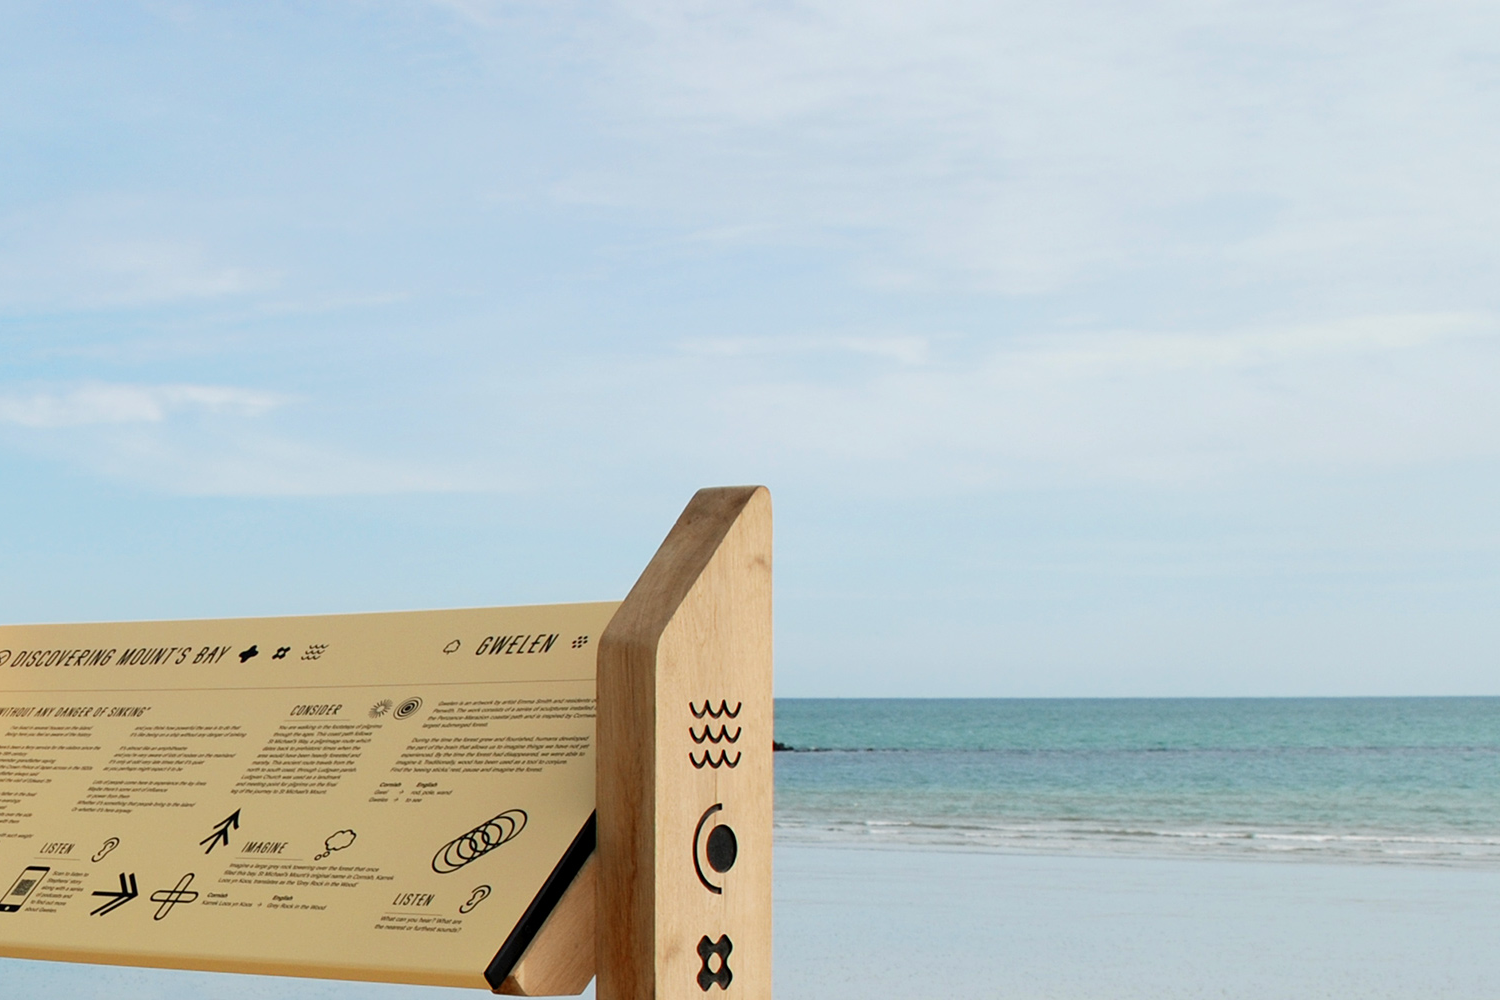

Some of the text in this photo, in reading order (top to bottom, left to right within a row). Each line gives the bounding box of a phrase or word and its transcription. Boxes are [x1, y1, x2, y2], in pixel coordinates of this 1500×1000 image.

[476, 634, 559, 655] GWELEN
[10, 646, 231, 667] DISCOVERING MOUNT'S BAY
[34, 707, 56, 717] ANY
[54, 707, 93, 717] DANGER
[93, 707, 108, 717] OF
[290, 704, 342, 716] CONSIDER
[415, 781, 438, 789] English
[40, 843, 75, 854] LISTEN
[241, 842, 288, 854] IMAGINE
[271, 894, 294, 902] English
[393, 893, 435, 906] LISTEN
